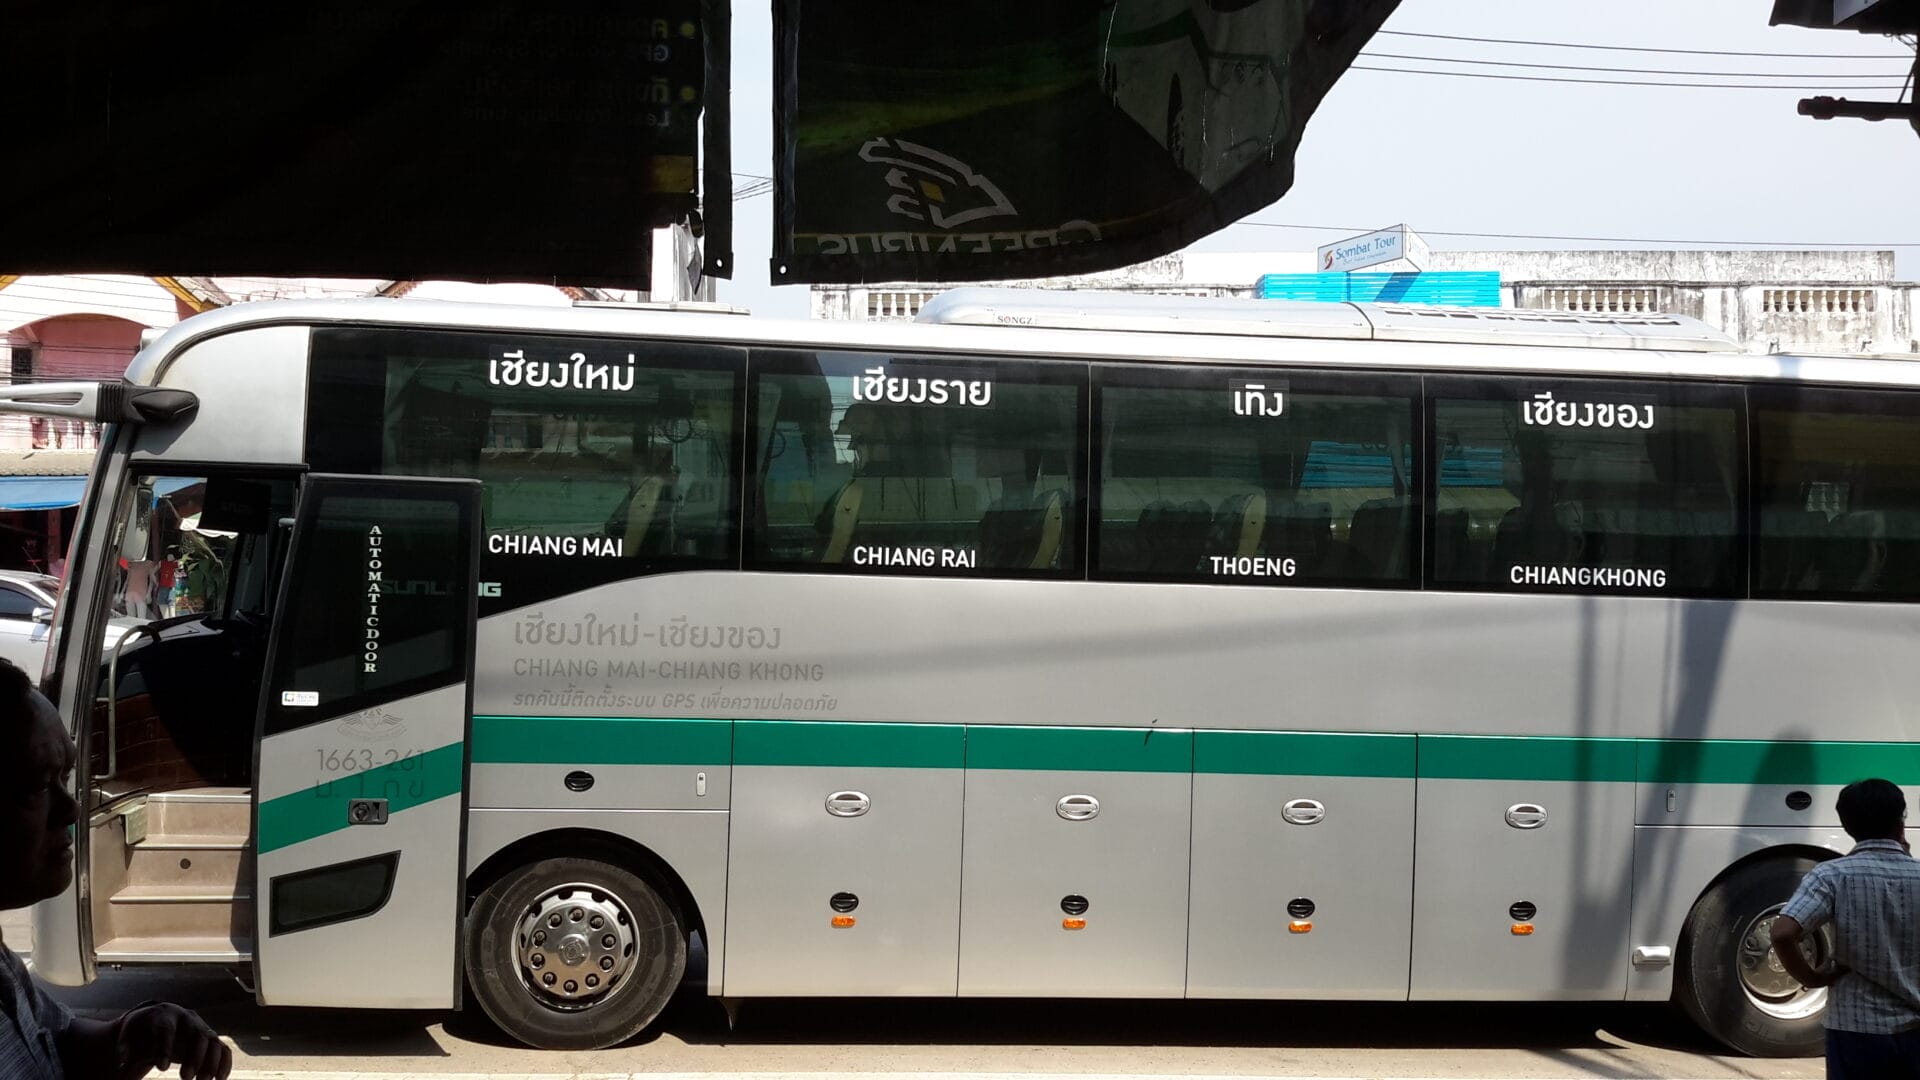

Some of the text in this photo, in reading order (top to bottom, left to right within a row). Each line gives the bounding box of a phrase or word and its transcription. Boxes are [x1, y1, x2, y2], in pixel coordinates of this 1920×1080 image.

[1335, 243, 1370, 260] Sombat
[1374, 236, 1396, 249] Tour
[997, 315, 1033, 325] SONGZ
[488, 349, 636, 392] เชียงใหม่
[852, 366, 992, 406] เชียงราย
[1233, 383, 1284, 417] เทิง
[1523, 391, 1655, 429] เชียงของ
[488, 534, 624, 557] CHIANG MAI
[853, 545, 977, 568] CHIANG RAI
[1209, 556, 1297, 577] THOENG
[1510, 565, 1667, 588] CHIANGKHONG
[513, 657, 599, 678] CHIANG
[749, 661, 824, 682] KHONG
[662, 692, 696, 709] GPS
[317, 748, 425, 772] 1663-261
